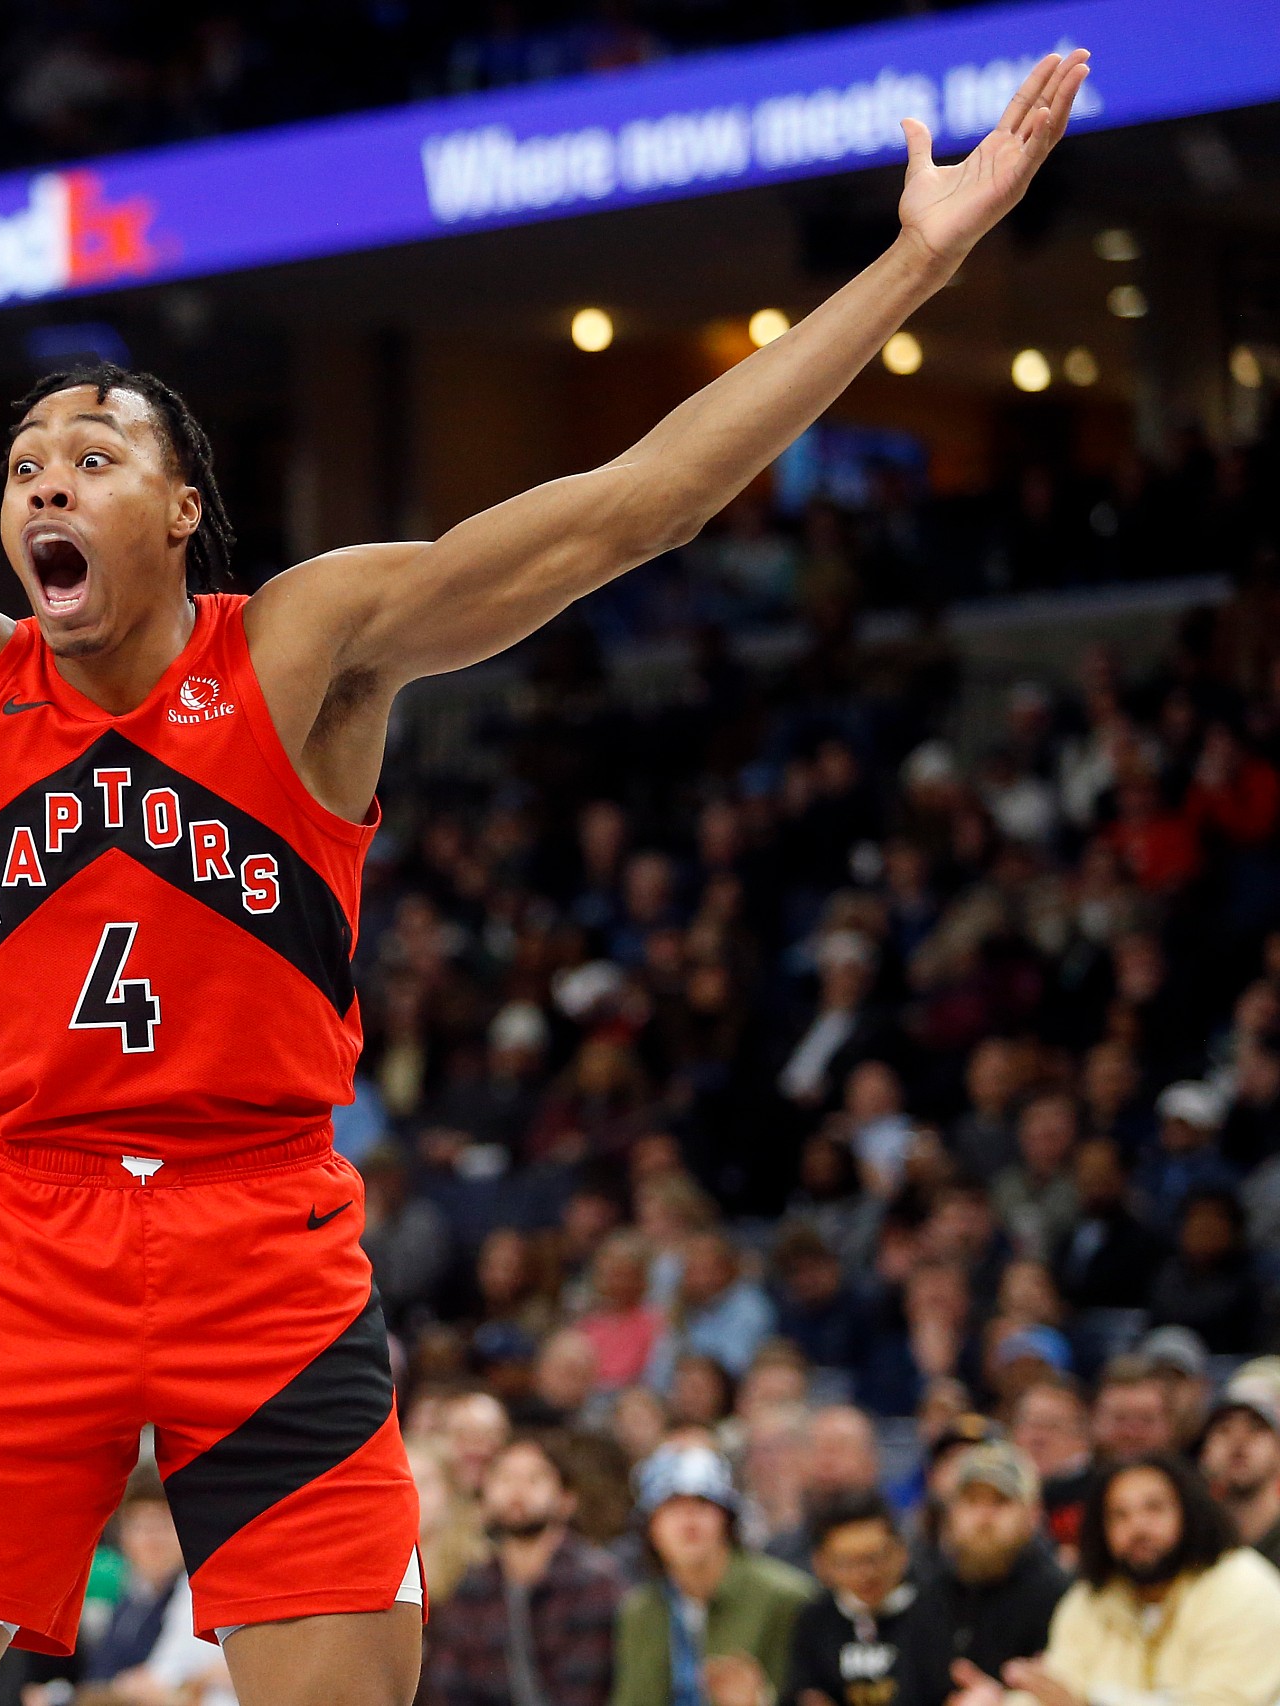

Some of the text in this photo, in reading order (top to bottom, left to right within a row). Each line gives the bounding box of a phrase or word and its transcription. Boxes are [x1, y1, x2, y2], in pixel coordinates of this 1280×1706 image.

[423, 124, 614, 222] Where
[623, 106, 749, 191] now
[755, 69, 940, 172] meets
[168, 702, 235, 723] Sun Life
[68, 922, 161, 1053] 4
